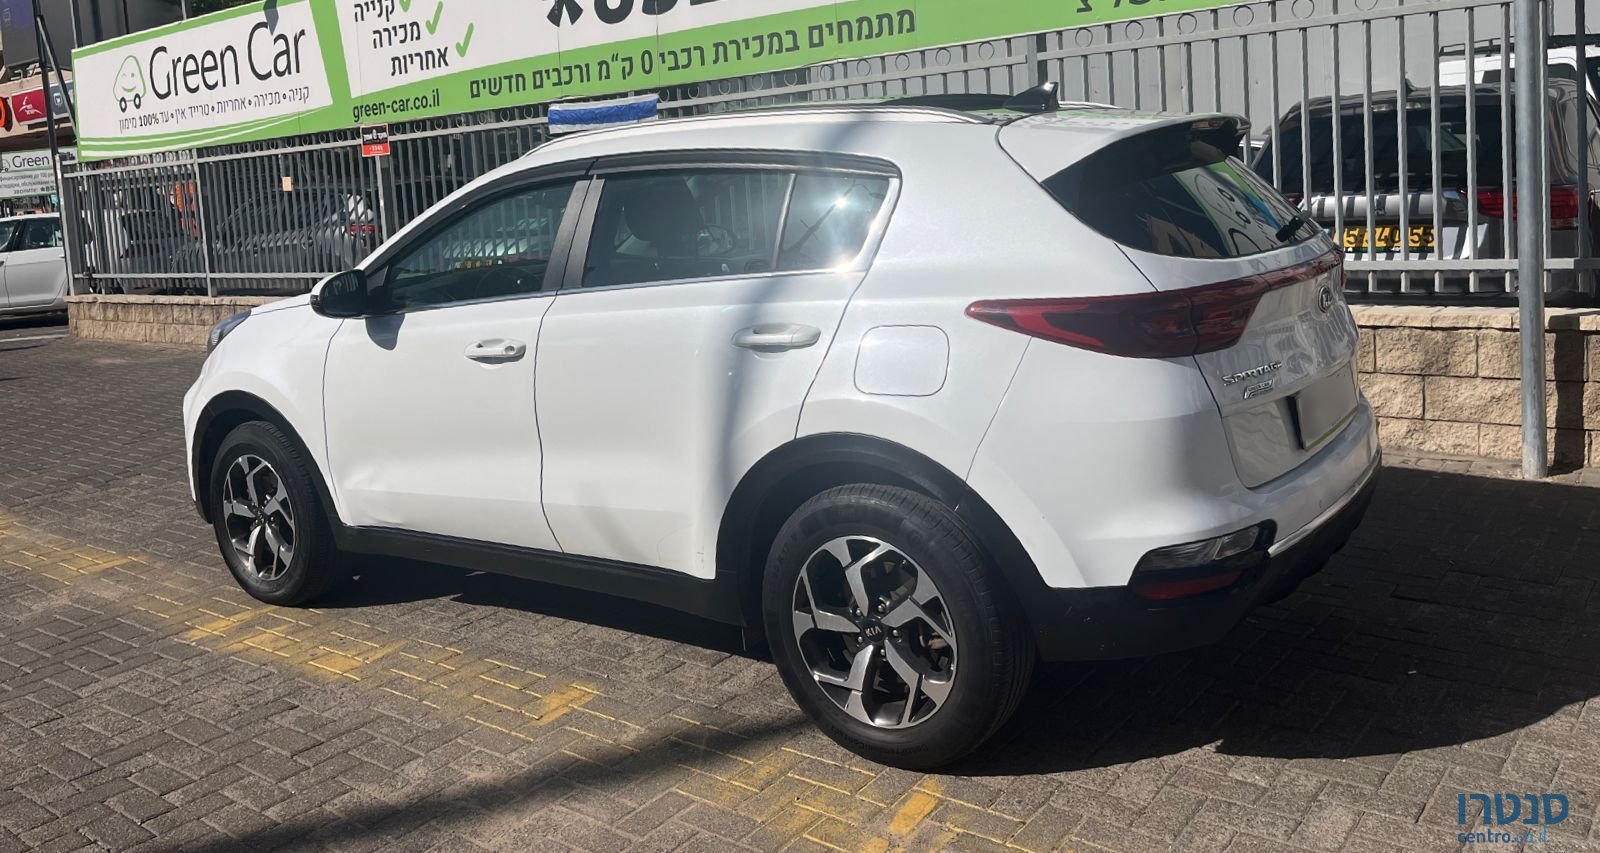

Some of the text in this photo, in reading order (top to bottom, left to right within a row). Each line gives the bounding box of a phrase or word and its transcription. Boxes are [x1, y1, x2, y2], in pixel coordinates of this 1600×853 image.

[353, 0, 396, 23] קנייה
[372, 21, 421, 49] מכירה
[807, 9, 916, 49] מתמחים
[658, 46, 706, 72] רכבי
[712, 29, 801, 65] במכירת
[149, 21, 306, 100] Green Car
[390, 46, 450, 77] אחריות
[640, 49, 654, 75] 0
[469, 72, 527, 99] חדשים
[532, 62, 591, 90] ורכבים
[216, 98, 247, 116] אחריות
[253, 93, 281, 110] מכירה
[288, 86, 310, 104] קניה
[352, 88, 441, 123] green-car.co.il
[139, 112, 159, 128] 100%
[188, 102, 210, 119] טרייד
[118, 115, 137, 134] מימון
[12, 155, 50, 168] Green
[865, 626, 882, 637] KIA
